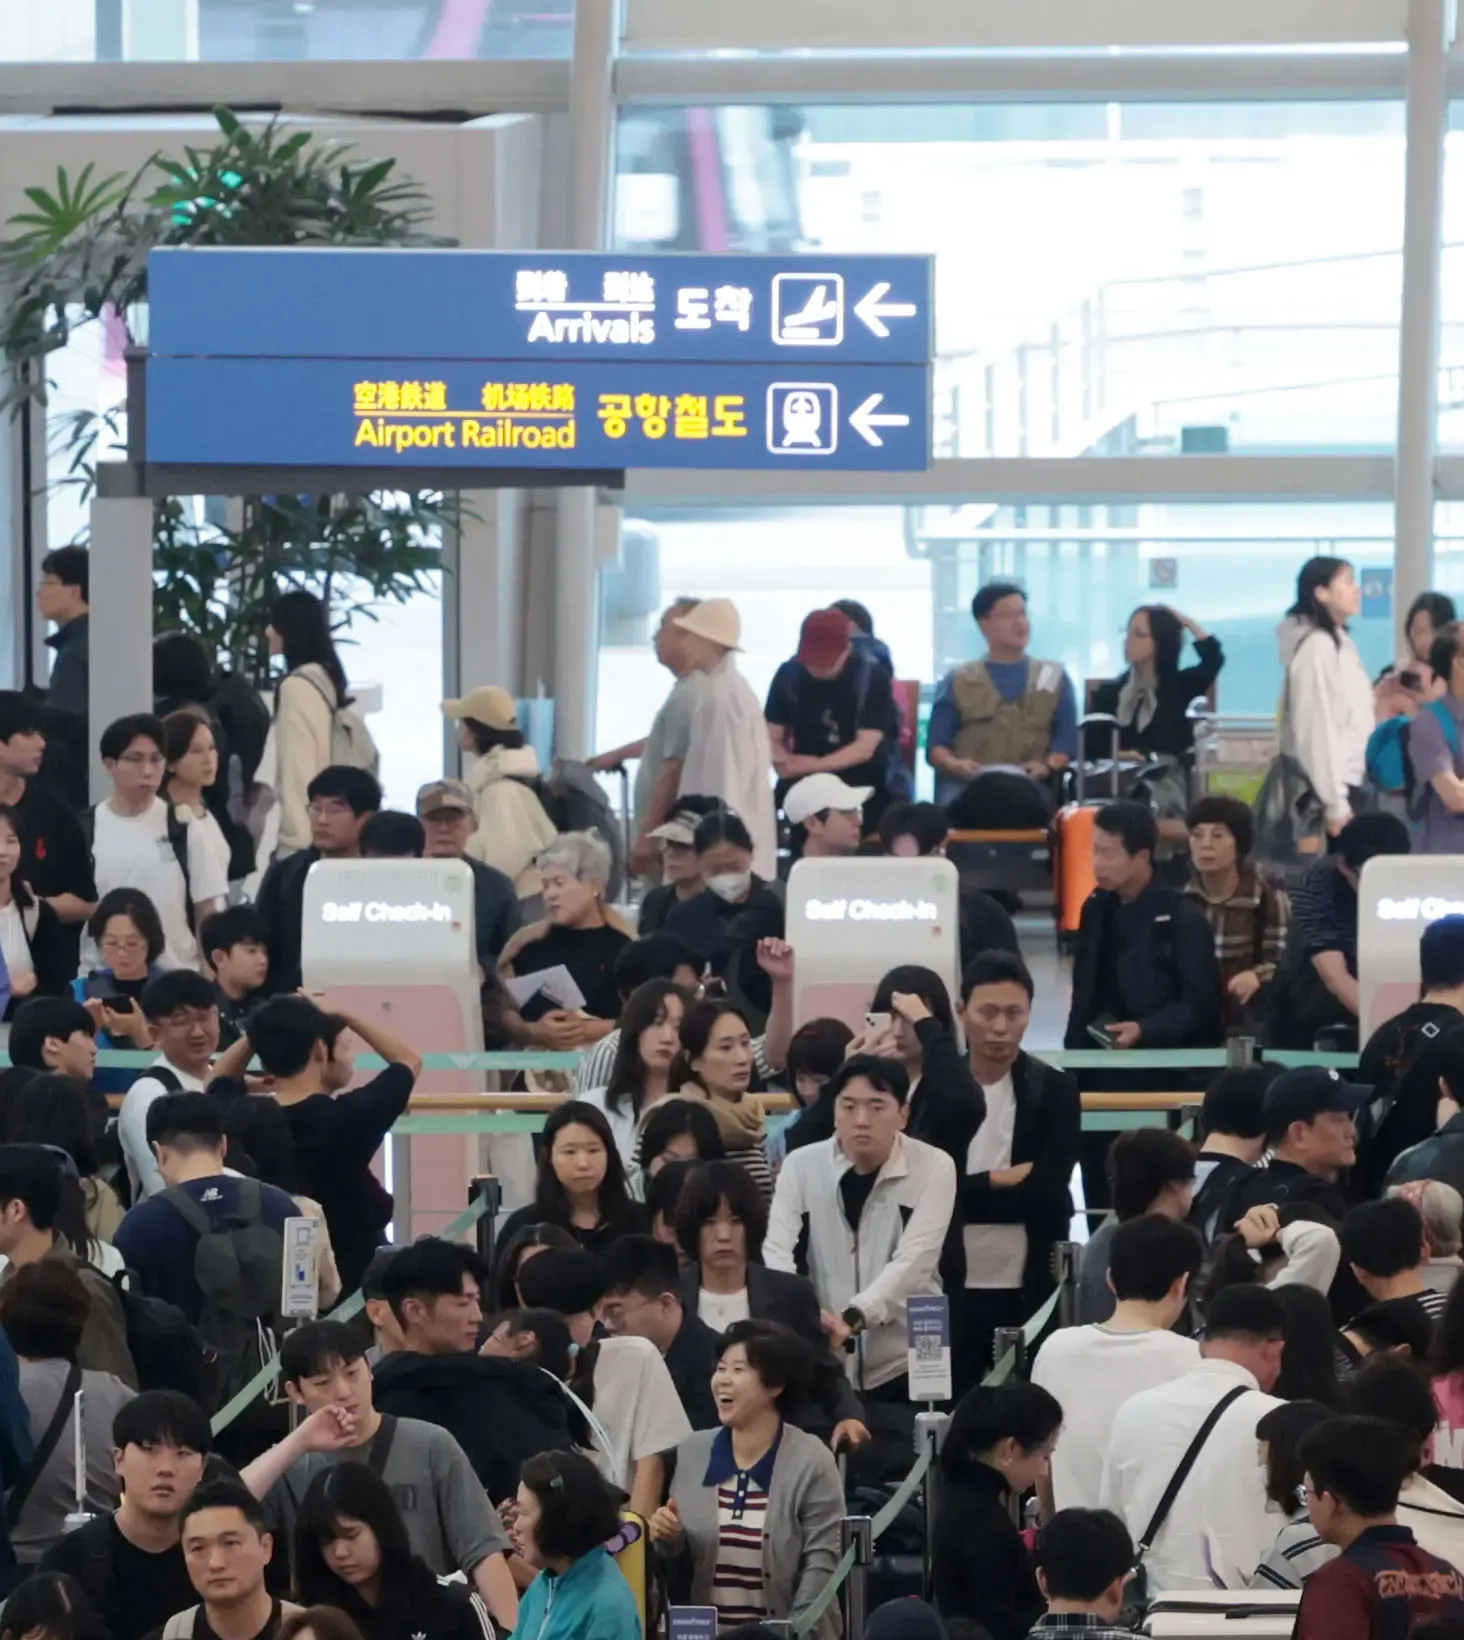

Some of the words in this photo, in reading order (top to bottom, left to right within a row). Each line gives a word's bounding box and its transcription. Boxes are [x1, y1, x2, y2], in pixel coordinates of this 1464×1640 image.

[674, 285, 753, 332] 도착
[528, 311, 655, 344] Arrivals
[597, 393, 748, 440] 공항철도
[355, 420, 455, 453] Airport
[462, 418, 576, 448] Railroad
[322, 902, 361, 922] Self
[805, 899, 845, 920] Self
[1377, 897, 1418, 920] Self
